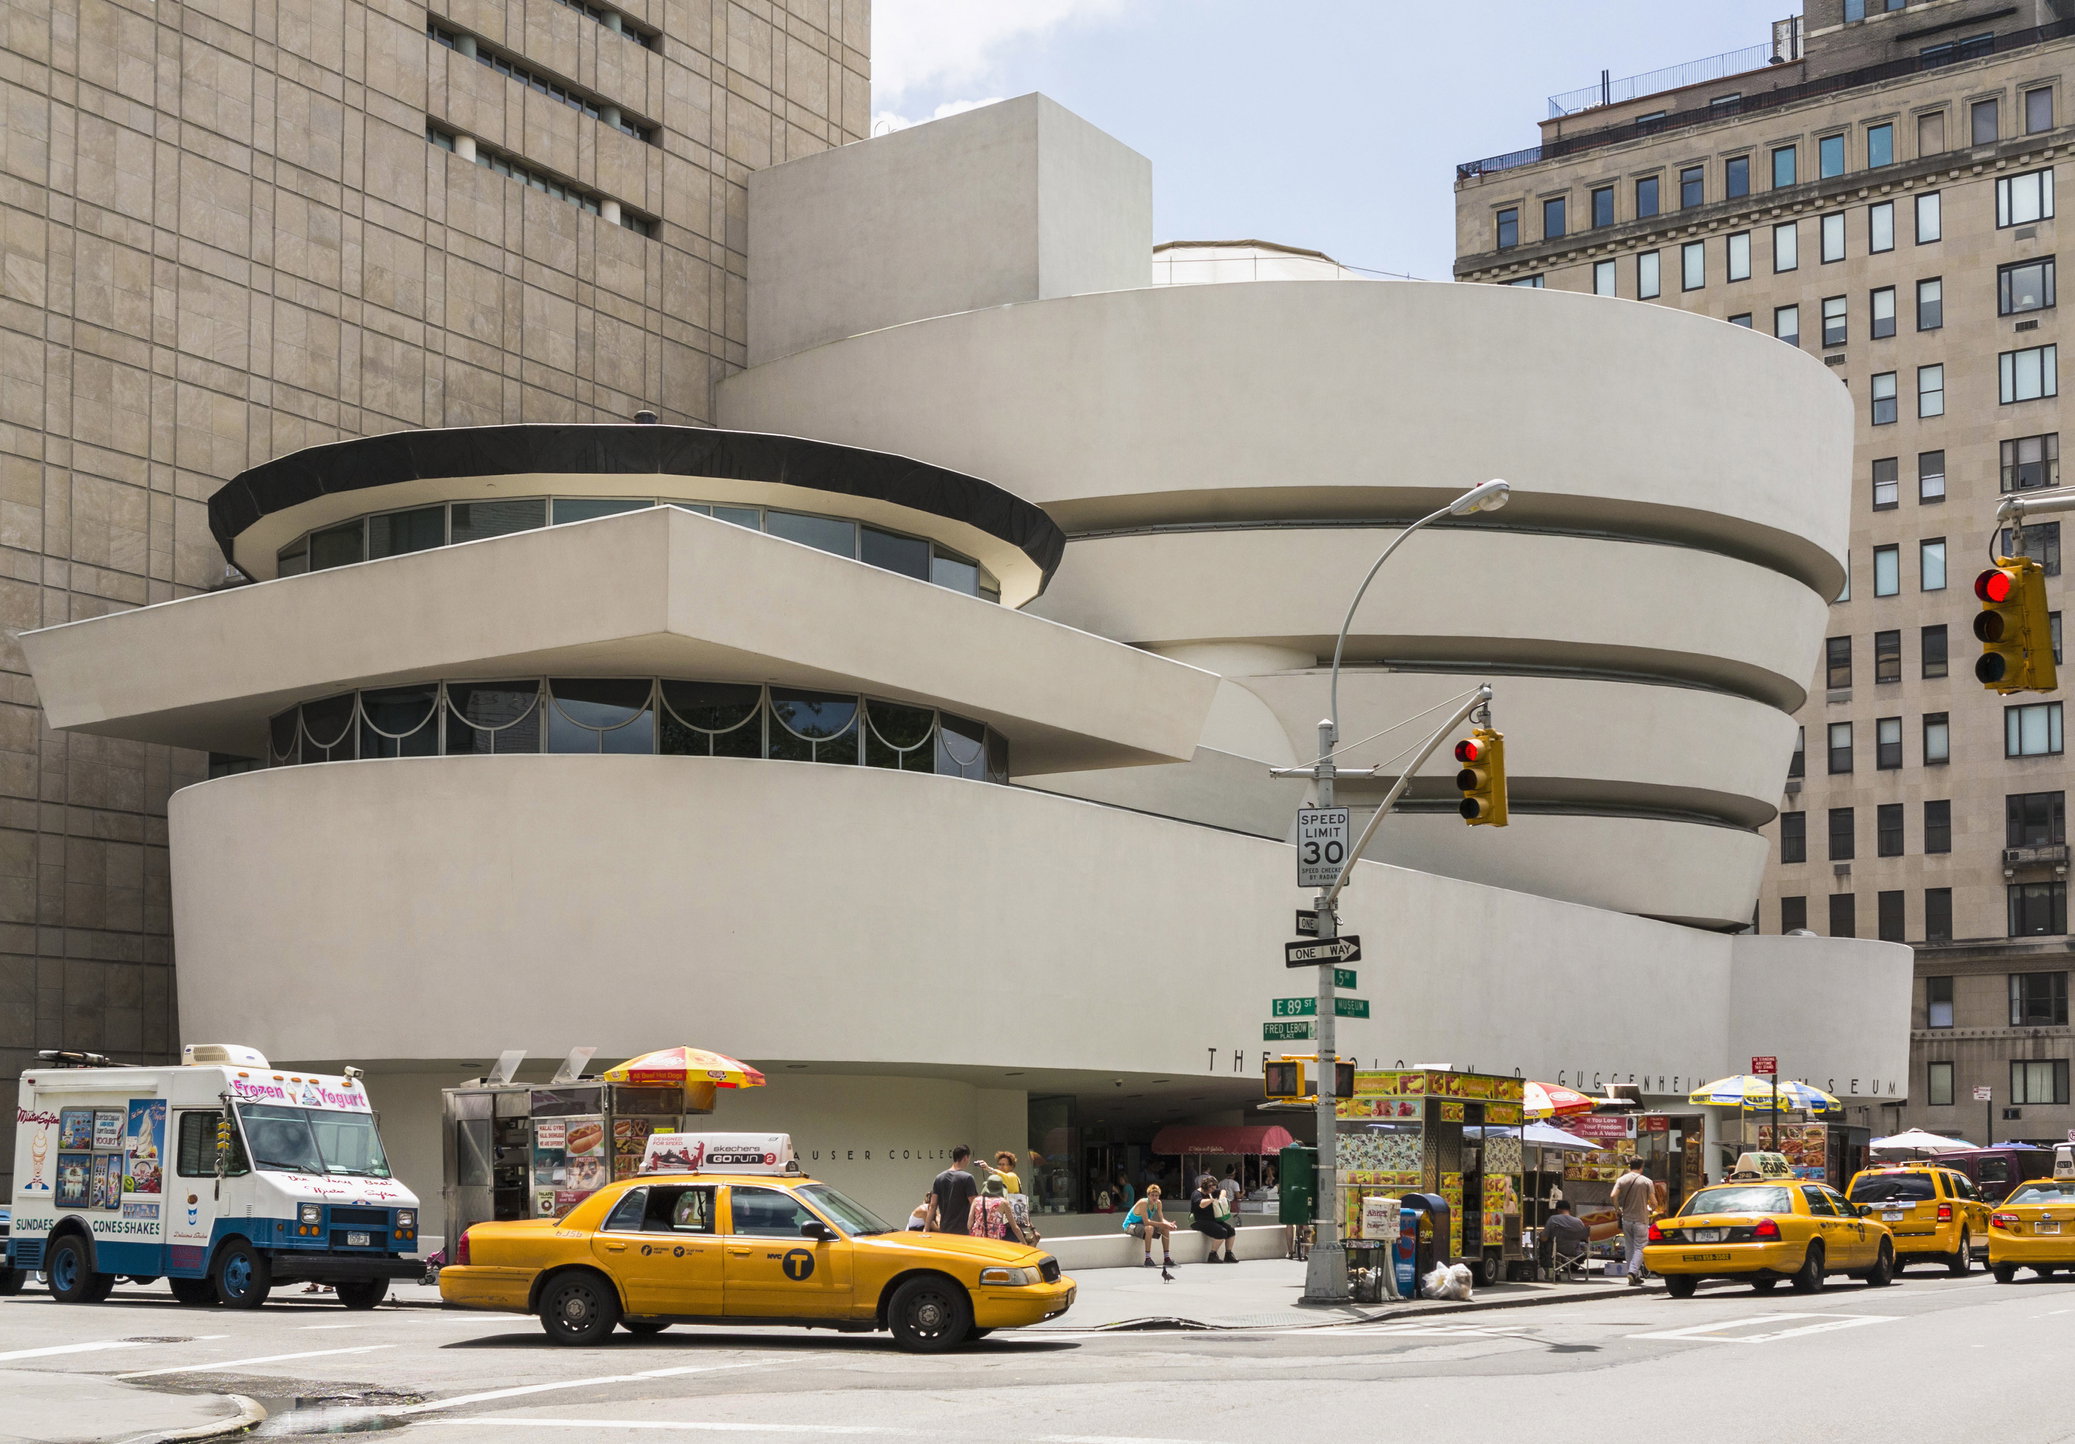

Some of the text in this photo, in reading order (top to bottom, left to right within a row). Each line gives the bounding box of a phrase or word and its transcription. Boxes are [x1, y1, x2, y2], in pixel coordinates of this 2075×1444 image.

[1301, 814, 1346, 825] SPEED
[1305, 827, 1341, 838] LIMIT
[1303, 840, 1344, 865] 30
[1301, 918, 1314, 929] ONE
[1295, 944, 1352, 959] ONE WAY
[1337, 971, 1344, 986] 5
[1276, 999, 1312, 1015] E 89 ST
[1337, 1000, 1364, 1011] MUSEUM
[1264, 1023, 1307, 1034] FRED LEBOW
[233, 1079, 366, 1108] Frozen Yogurt
[713, 1144, 760, 1152] skechers
[766, 1154, 775, 1163] 2
[15, 1218, 55, 1232] SUNDAES
[790, 1253, 808, 1277] T
